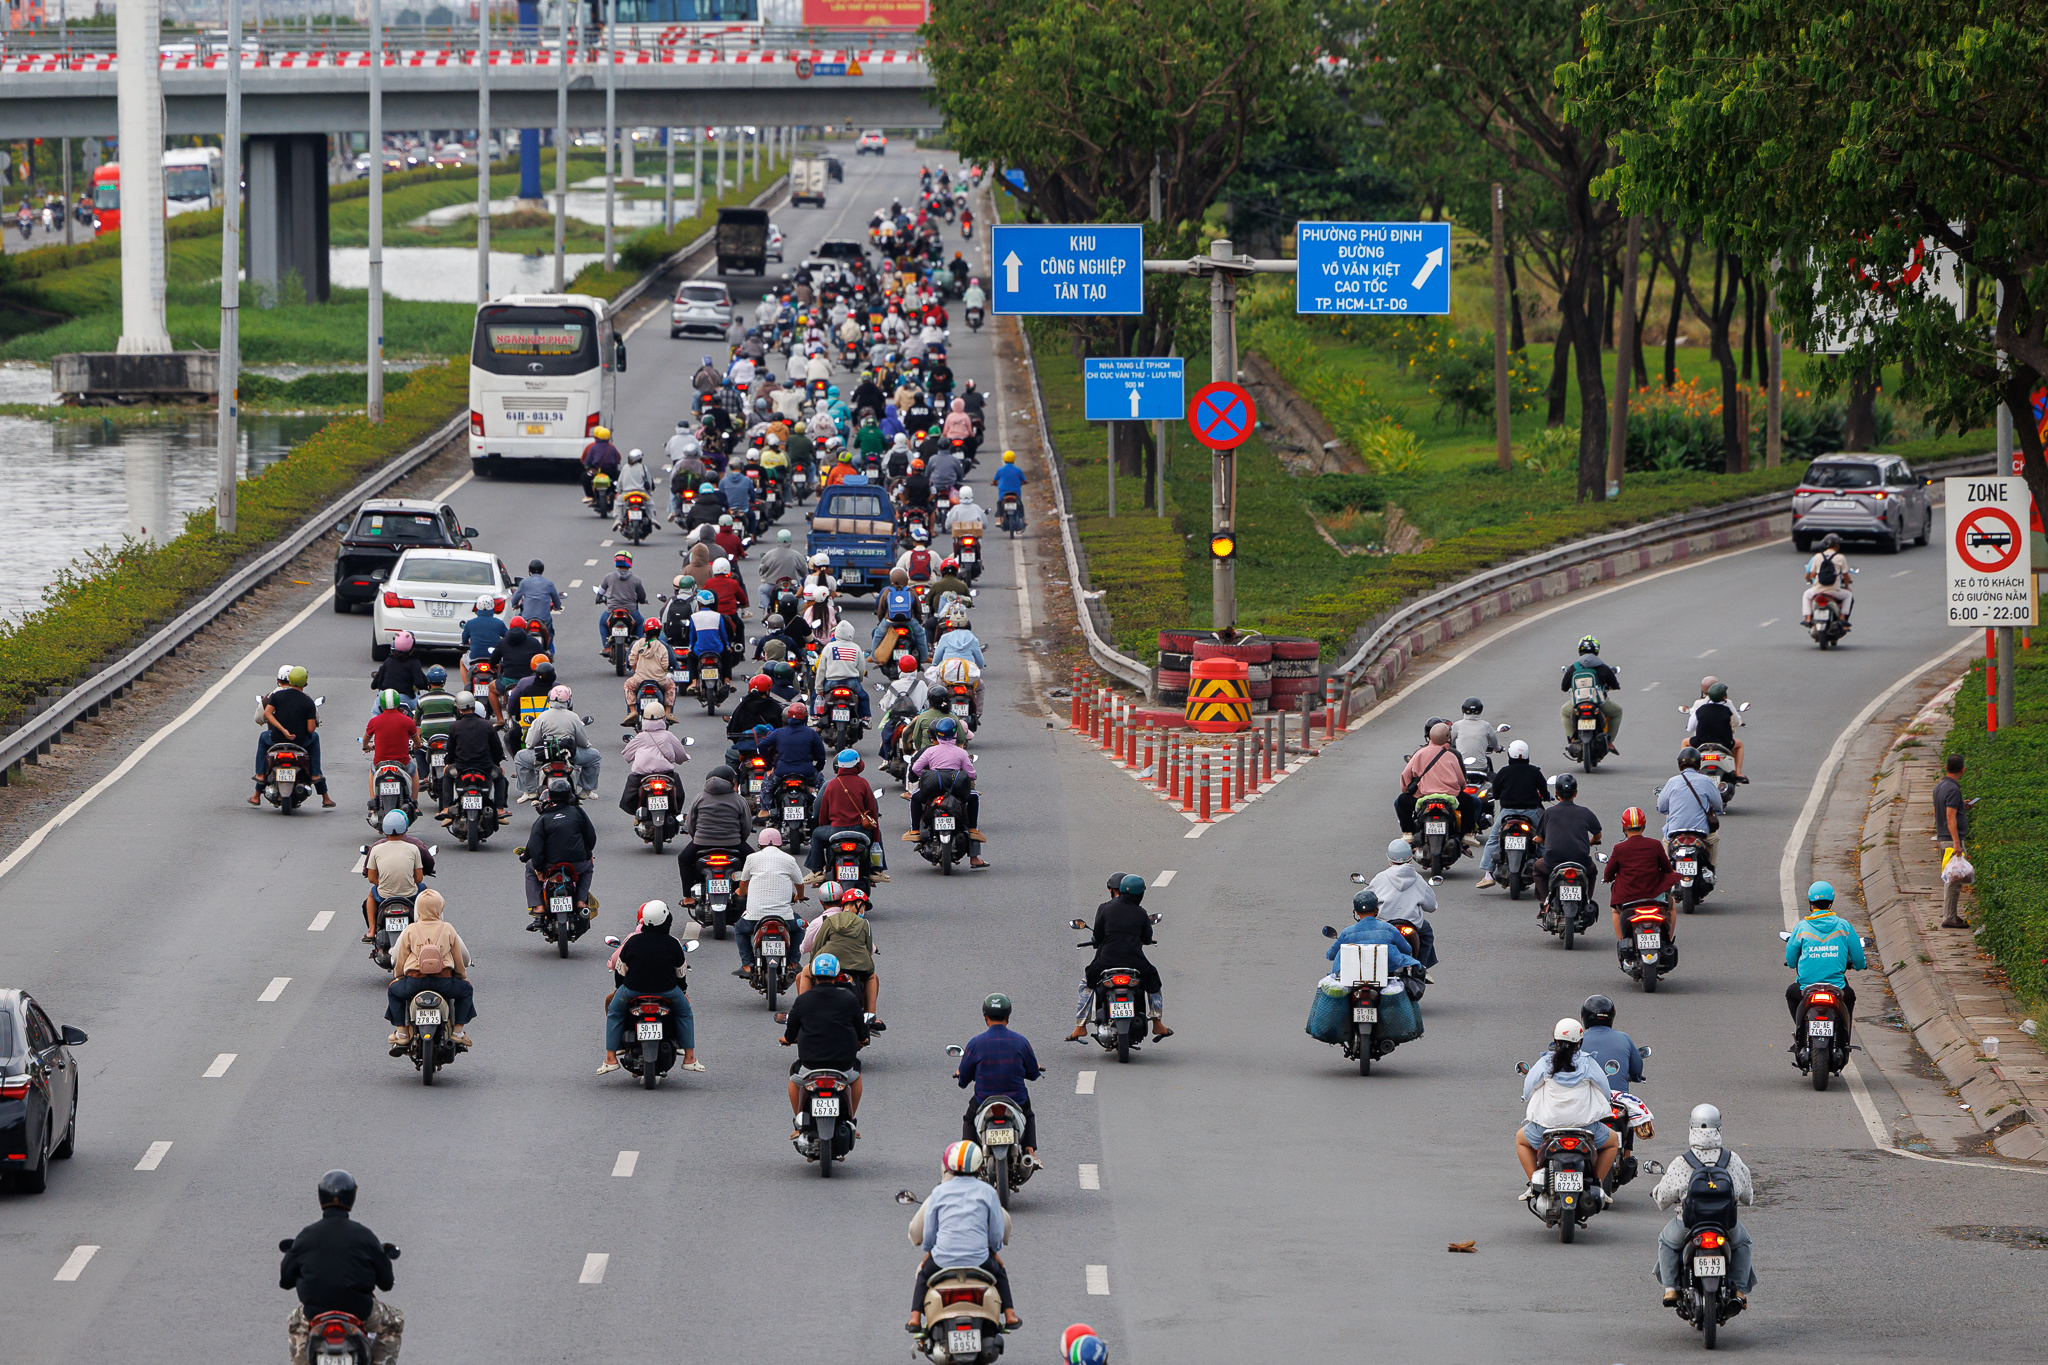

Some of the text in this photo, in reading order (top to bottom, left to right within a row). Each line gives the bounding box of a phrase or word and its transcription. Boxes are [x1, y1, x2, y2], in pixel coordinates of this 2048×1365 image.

[1302, 226, 1422, 244] PHƯỜNG PHÚ ĐỊNH
[1070, 236, 1096, 251] KHU
[1338, 243, 1384, 258] ĐƯỜNG
[1040, 256, 1126, 277] CÔNG NGHIỆP
[1322, 261, 1401, 278] VÕ VĂN KIỆT
[1334, 276, 1388, 293] CAO TỐC
[1054, 281, 1106, 302] TÂN TẠO
[1316, 298, 1408, 311] TP. HCM-LT-DG
[528, 334, 546, 344] KIM
[548, 334, 574, 345] PHÁT
[1099, 361, 1114, 369] NHÀ
[1086, 372, 1098, 380] CHI
[1100, 372, 1114, 381] CỤC
[1115, 371, 1130, 379] VĂN
[1968, 484, 2008, 502] ZONE
[1954, 576, 2024, 588] XE Ô TÔ KHÁCH
[1952, 588, 2027, 602] CÓ GIƯỜNG NẰM
[1950, 608, 1978, 620] 6:00
[1993, 607, 2030, 620] 22:00
[1559, 1173, 1579, 1182] 59-K2
[1558, 1182, 1581, 1191] 822.23
[1699, 1258, 1720, 1266] 66-N3
[1699, 1266, 1721, 1275] 1727
[953, 1331, 976, 1341] 54-F4
[954, 1342, 976, 1352] 8954
